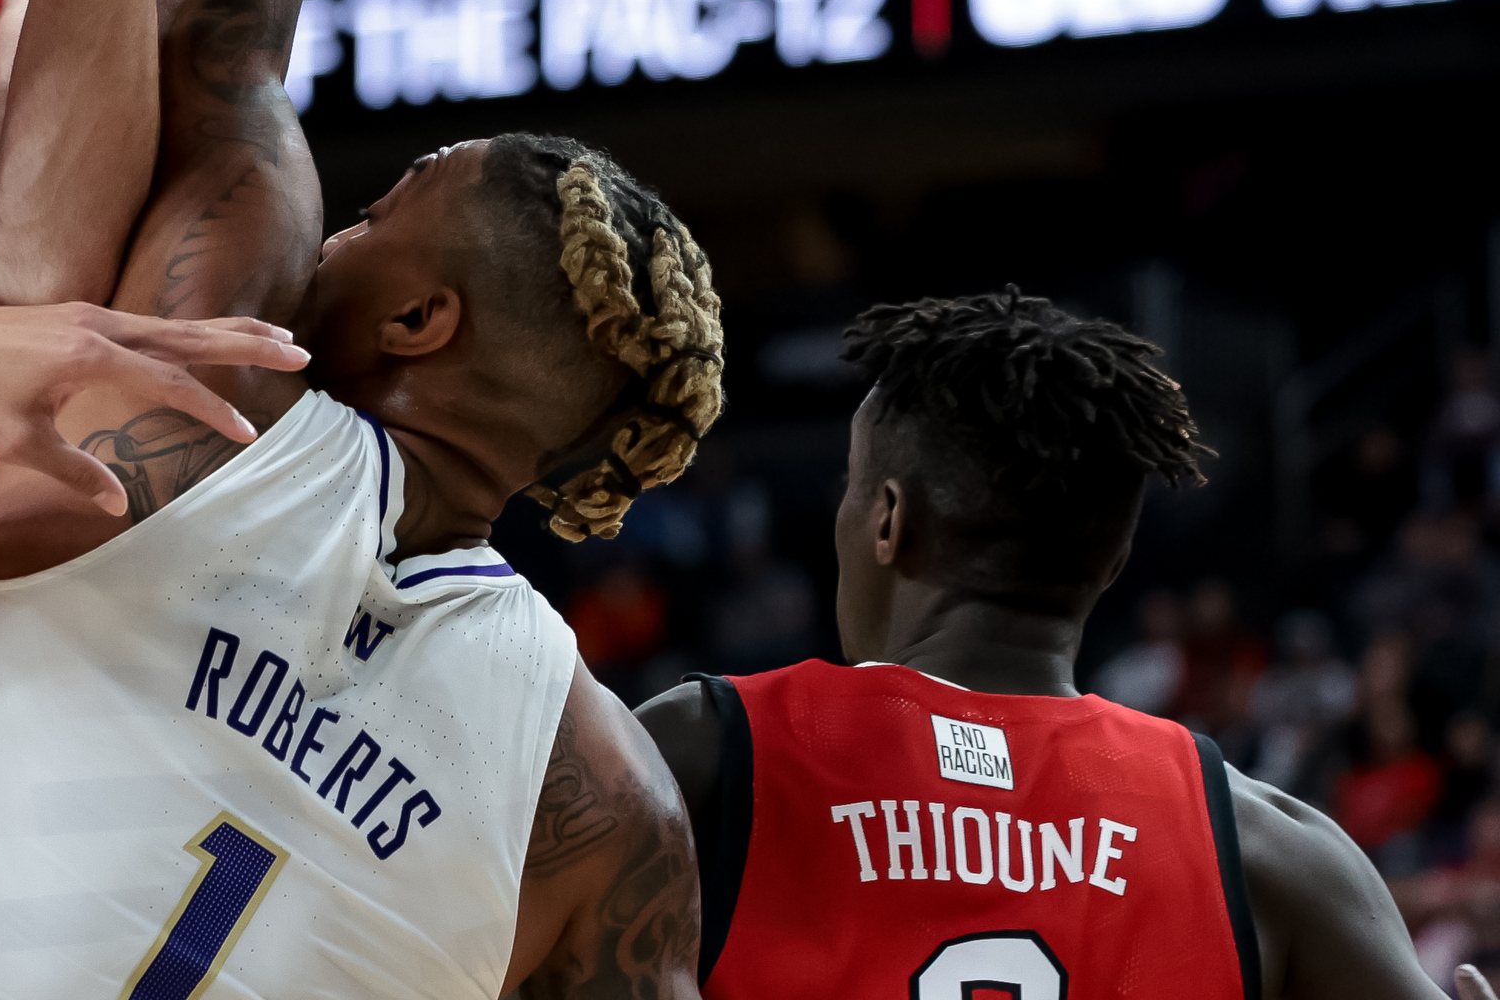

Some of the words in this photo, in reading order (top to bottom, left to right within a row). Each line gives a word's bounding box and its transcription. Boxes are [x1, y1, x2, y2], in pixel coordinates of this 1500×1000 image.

[185, 626, 442, 861] ROBERTS
[940, 744, 1011, 781] RACISM
[949, 723, 986, 751] END
[830, 799, 1138, 896] THIOUNE
